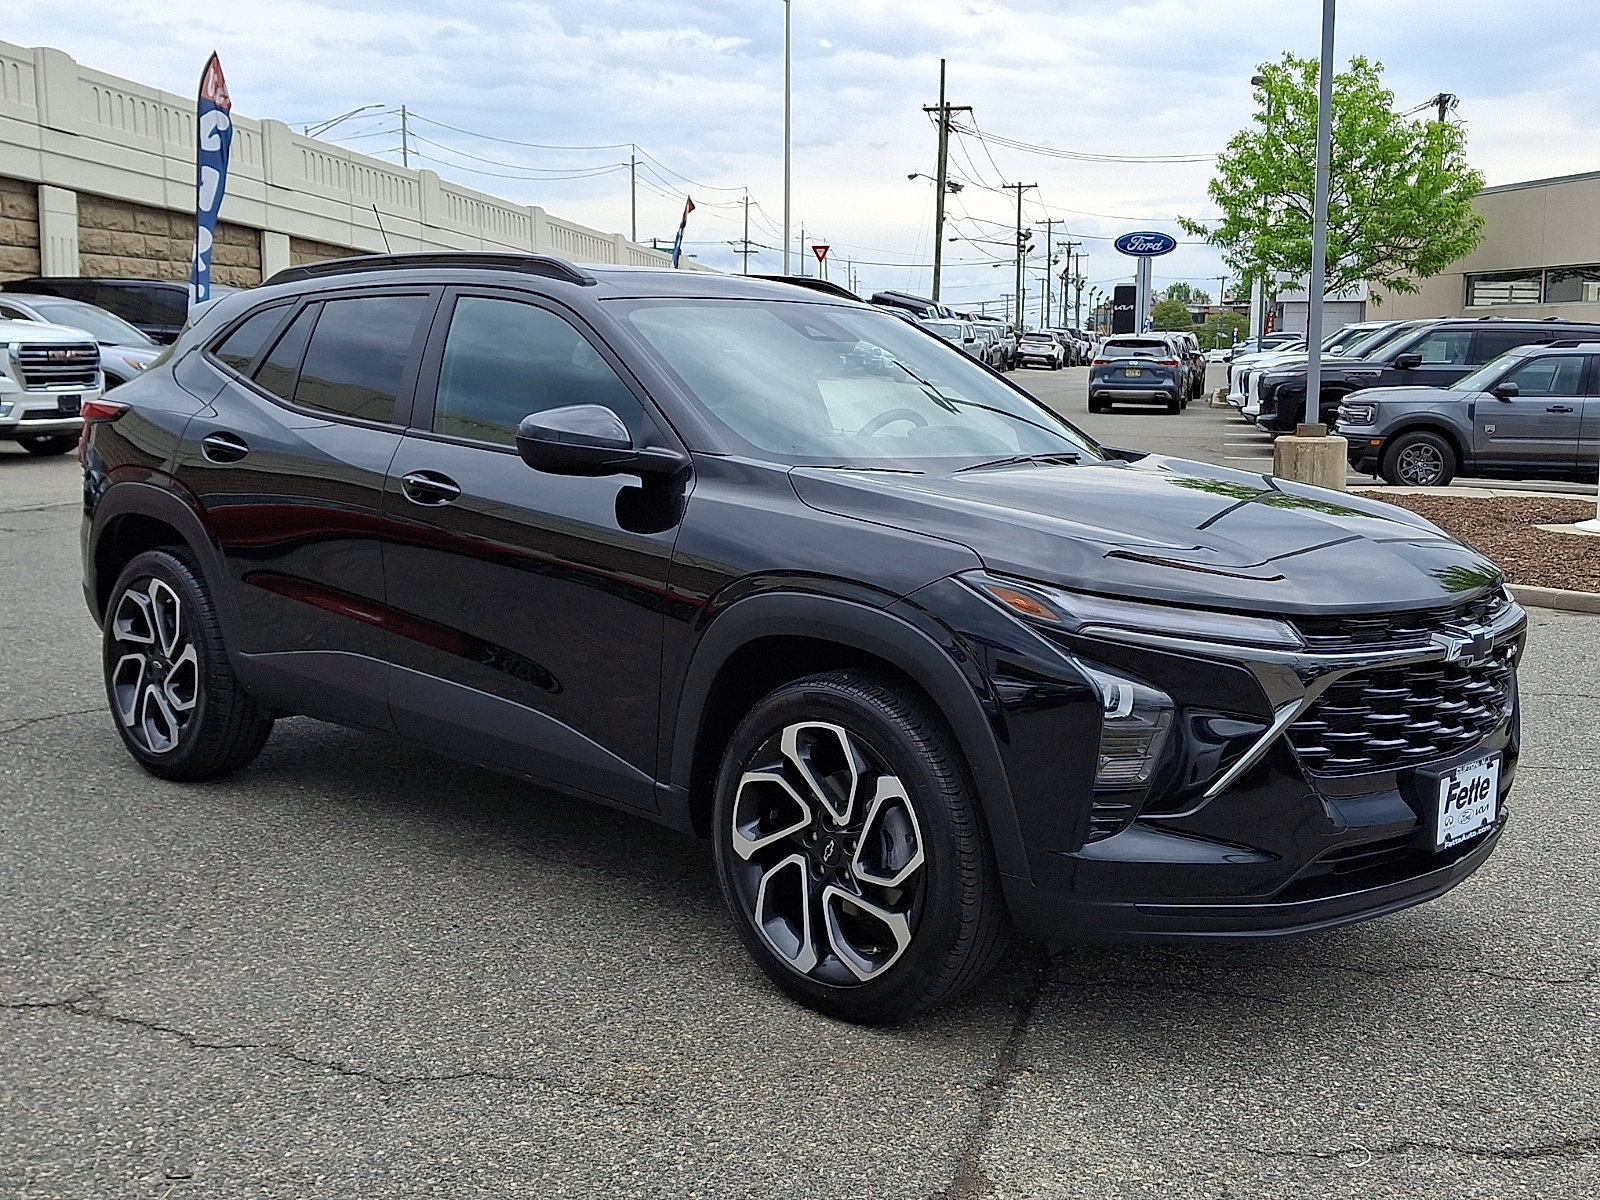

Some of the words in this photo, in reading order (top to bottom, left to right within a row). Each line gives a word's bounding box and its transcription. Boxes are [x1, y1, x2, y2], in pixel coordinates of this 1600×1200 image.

[1127, 235, 1165, 251] Ford
[1444, 776, 1490, 814] Fette
[1444, 825, 1492, 850] FetteAuto.com
